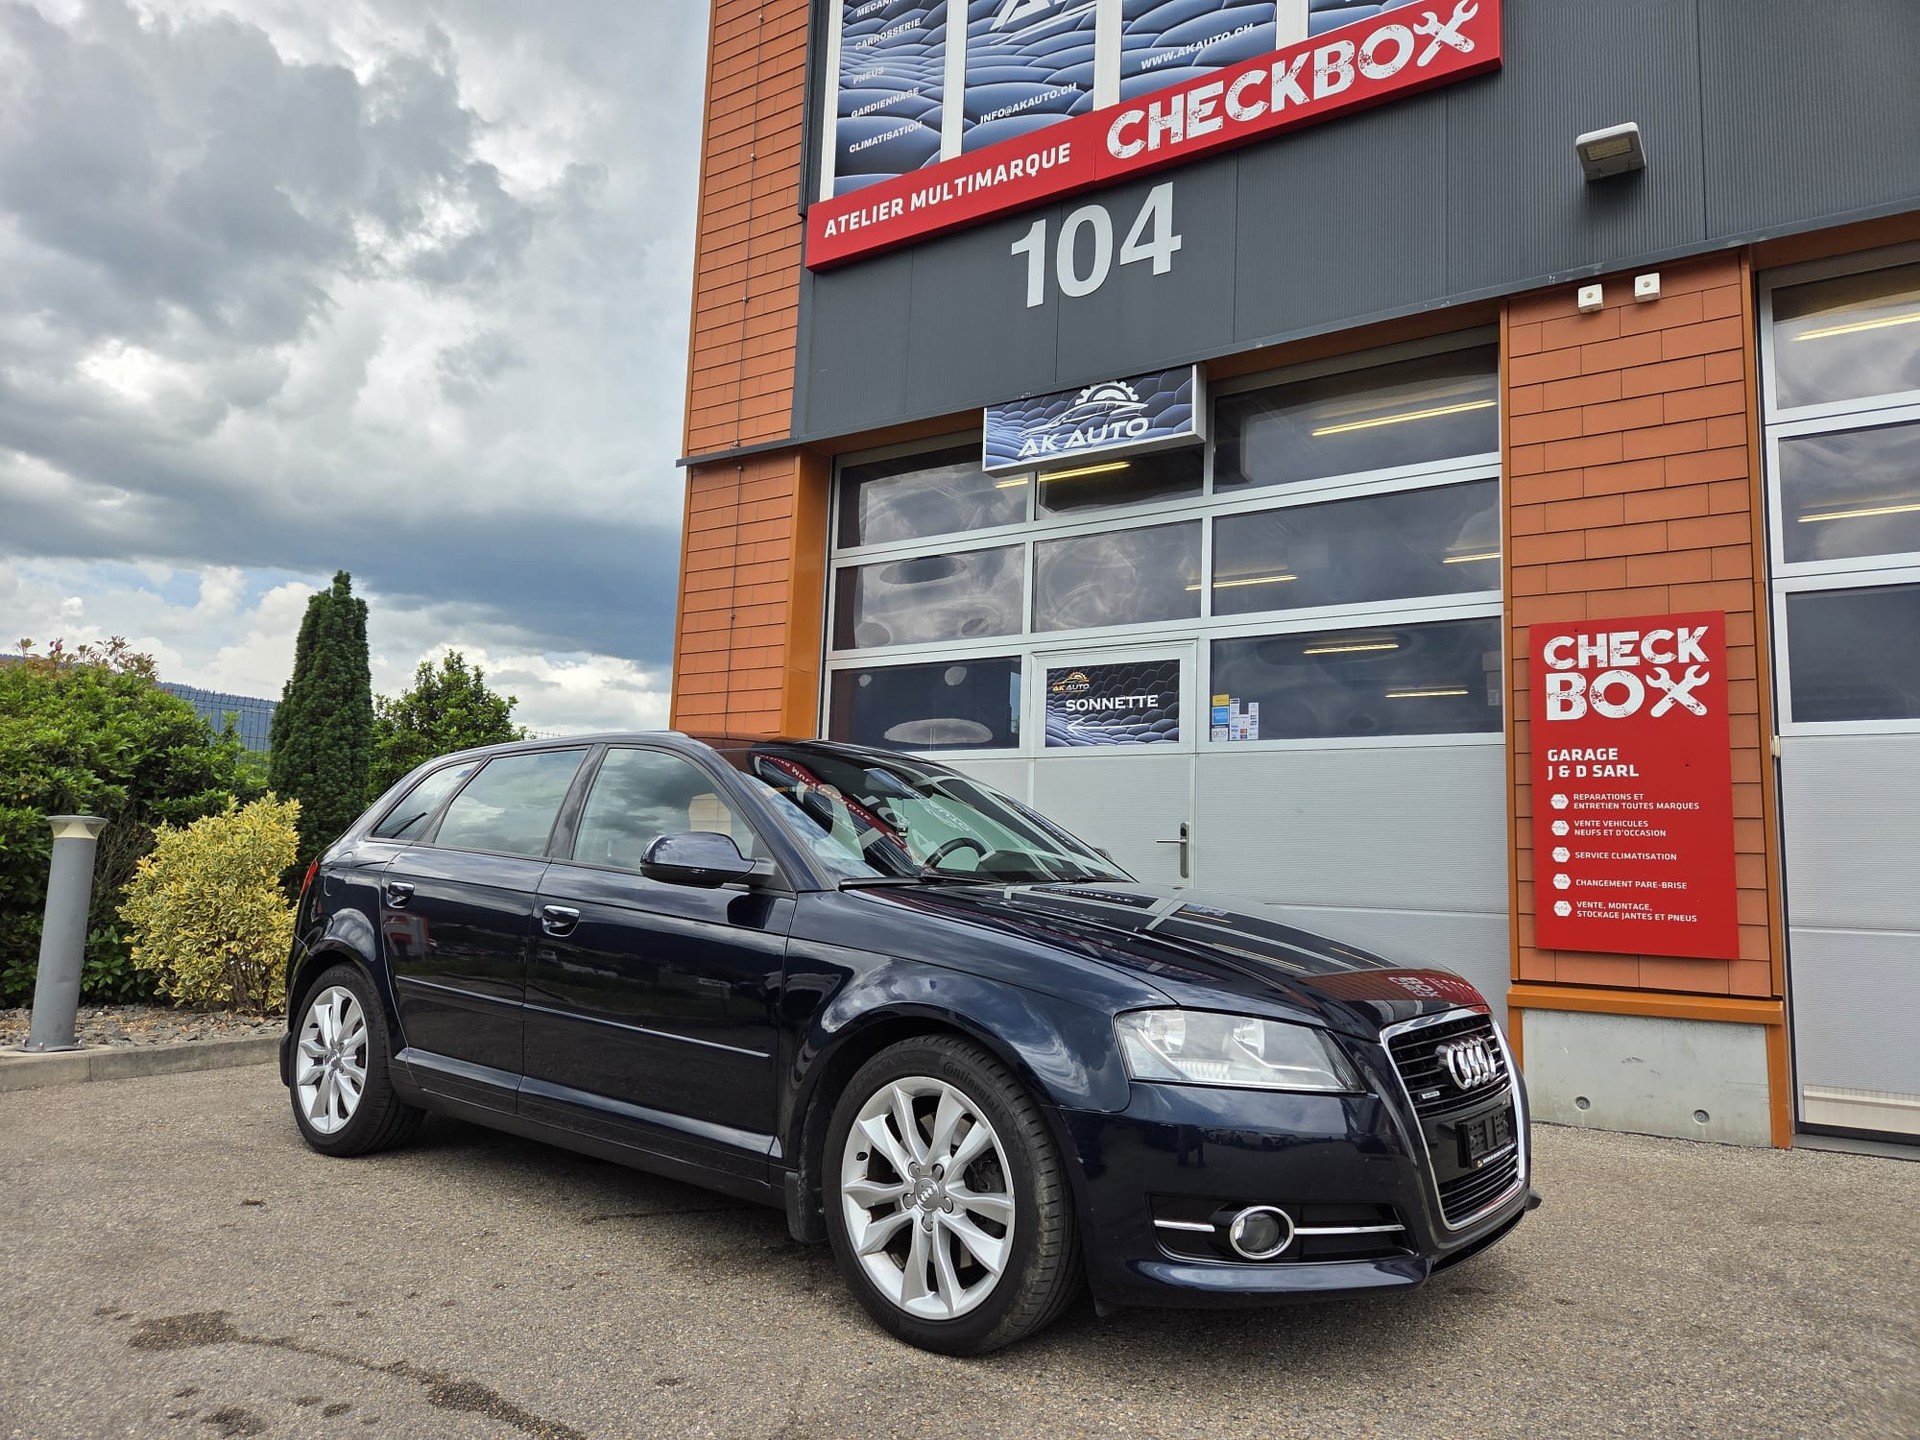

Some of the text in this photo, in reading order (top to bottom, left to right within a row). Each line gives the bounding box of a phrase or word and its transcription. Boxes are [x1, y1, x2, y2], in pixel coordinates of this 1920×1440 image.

[854, 18, 921, 50] CARROSSERIE
[1141, 23, 1254, 70] WWW.AKAUTO.CH
[853, 66, 884, 85] PNEUS
[851, 87, 920, 118] GARDIENNAGE
[980, 82, 1077, 124] INFO@AKAUTO.CH
[849, 121, 923, 153] CLIMATISATION
[824, 143, 1071, 238] ATELIER MULTIMARQUE
[1012, 181, 1182, 308] 104
[1017, 418, 1149, 457] AK AUTO
[1543, 626, 1710, 669] CHECK
[1066, 695, 1158, 712] SONNETTE
[1547, 747, 1618, 762] GARAGE
[1547, 764, 1639, 781] J & D SARL
[1573, 793, 1632, 801] REPARATIONS
[1573, 802, 1700, 810] ENTRETIEN TOUTES MARQUES
[1603, 820, 1649, 828] VEHICULES
[1616, 829, 1667, 837] D'OCCASION
[1611, 852, 1677, 861] CLIMATISATION
[1575, 879, 1688, 890] CHANGEMENT PARE-BRISE
[1576, 901, 1653, 911] VENTE, MONTAGE,
[1577, 911, 1619, 919] STOCKAGE
[1621, 912, 1652, 920] JANTES
[1655, 913, 1665, 921] ET
